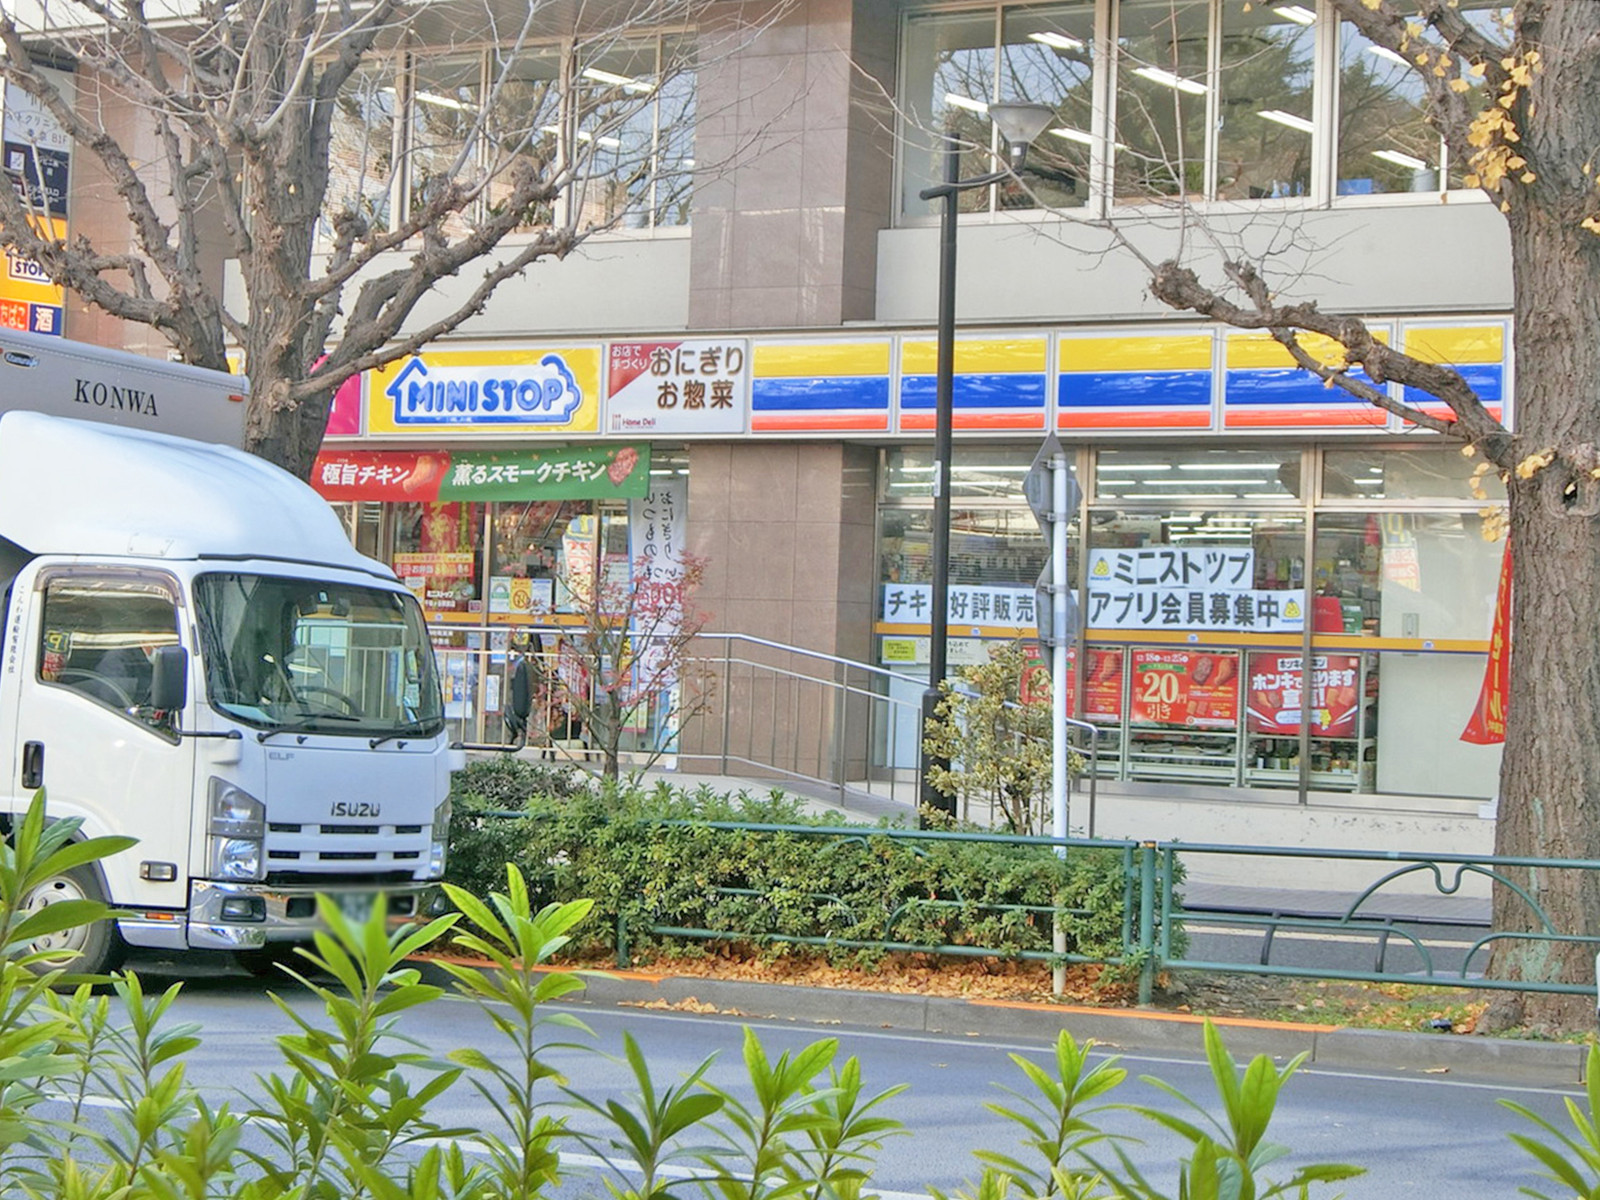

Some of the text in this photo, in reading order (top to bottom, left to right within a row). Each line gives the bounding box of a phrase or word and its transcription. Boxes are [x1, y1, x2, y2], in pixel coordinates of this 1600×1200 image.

[34, 306, 54, 332] 酒
[612, 345, 641, 357] お店で
[612, 358, 648, 370] 手づくり
[650, 346, 743, 376] おにぎり
[74, 378, 158, 416] KONWA
[407, 378, 563, 412] MINISTOP
[657, 380, 734, 410] お惣菜
[321, 464, 410, 486] 極旨チキン
[451, 460, 608, 487] 薫るスモークチキン
[888, 589, 1035, 623] チキ好評販売
[1090, 592, 1279, 627] アプリ会員募集中
[1147, 703, 1172, 719] 引き
[330, 801, 381, 818] ISUZU
